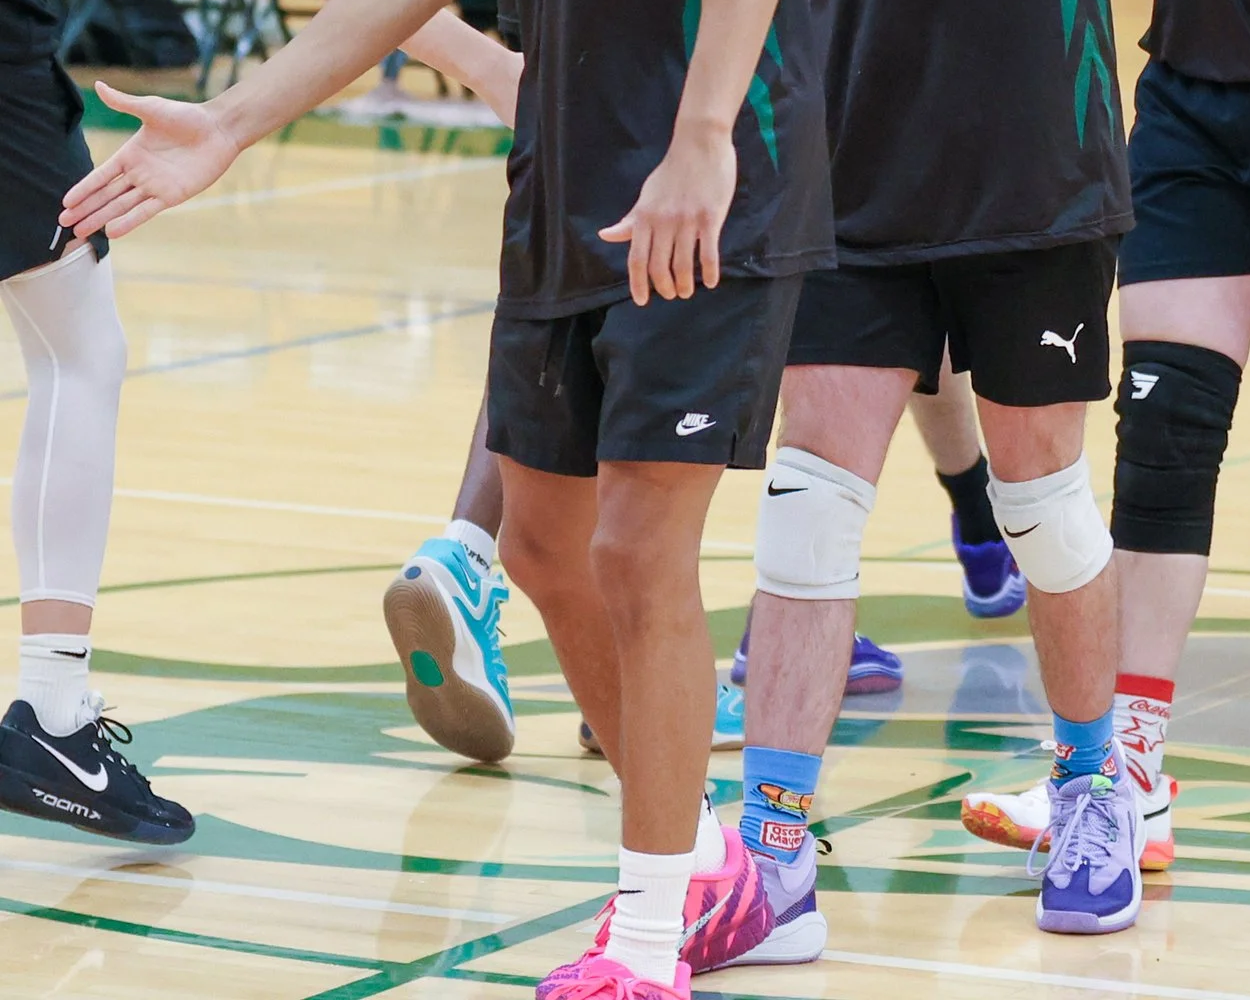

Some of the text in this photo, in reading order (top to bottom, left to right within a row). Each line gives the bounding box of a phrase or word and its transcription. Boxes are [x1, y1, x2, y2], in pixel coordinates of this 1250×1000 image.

[682, 412, 710, 427] NIKE
[772, 825, 803, 838] Osca
[769, 833, 802, 849] Maye
